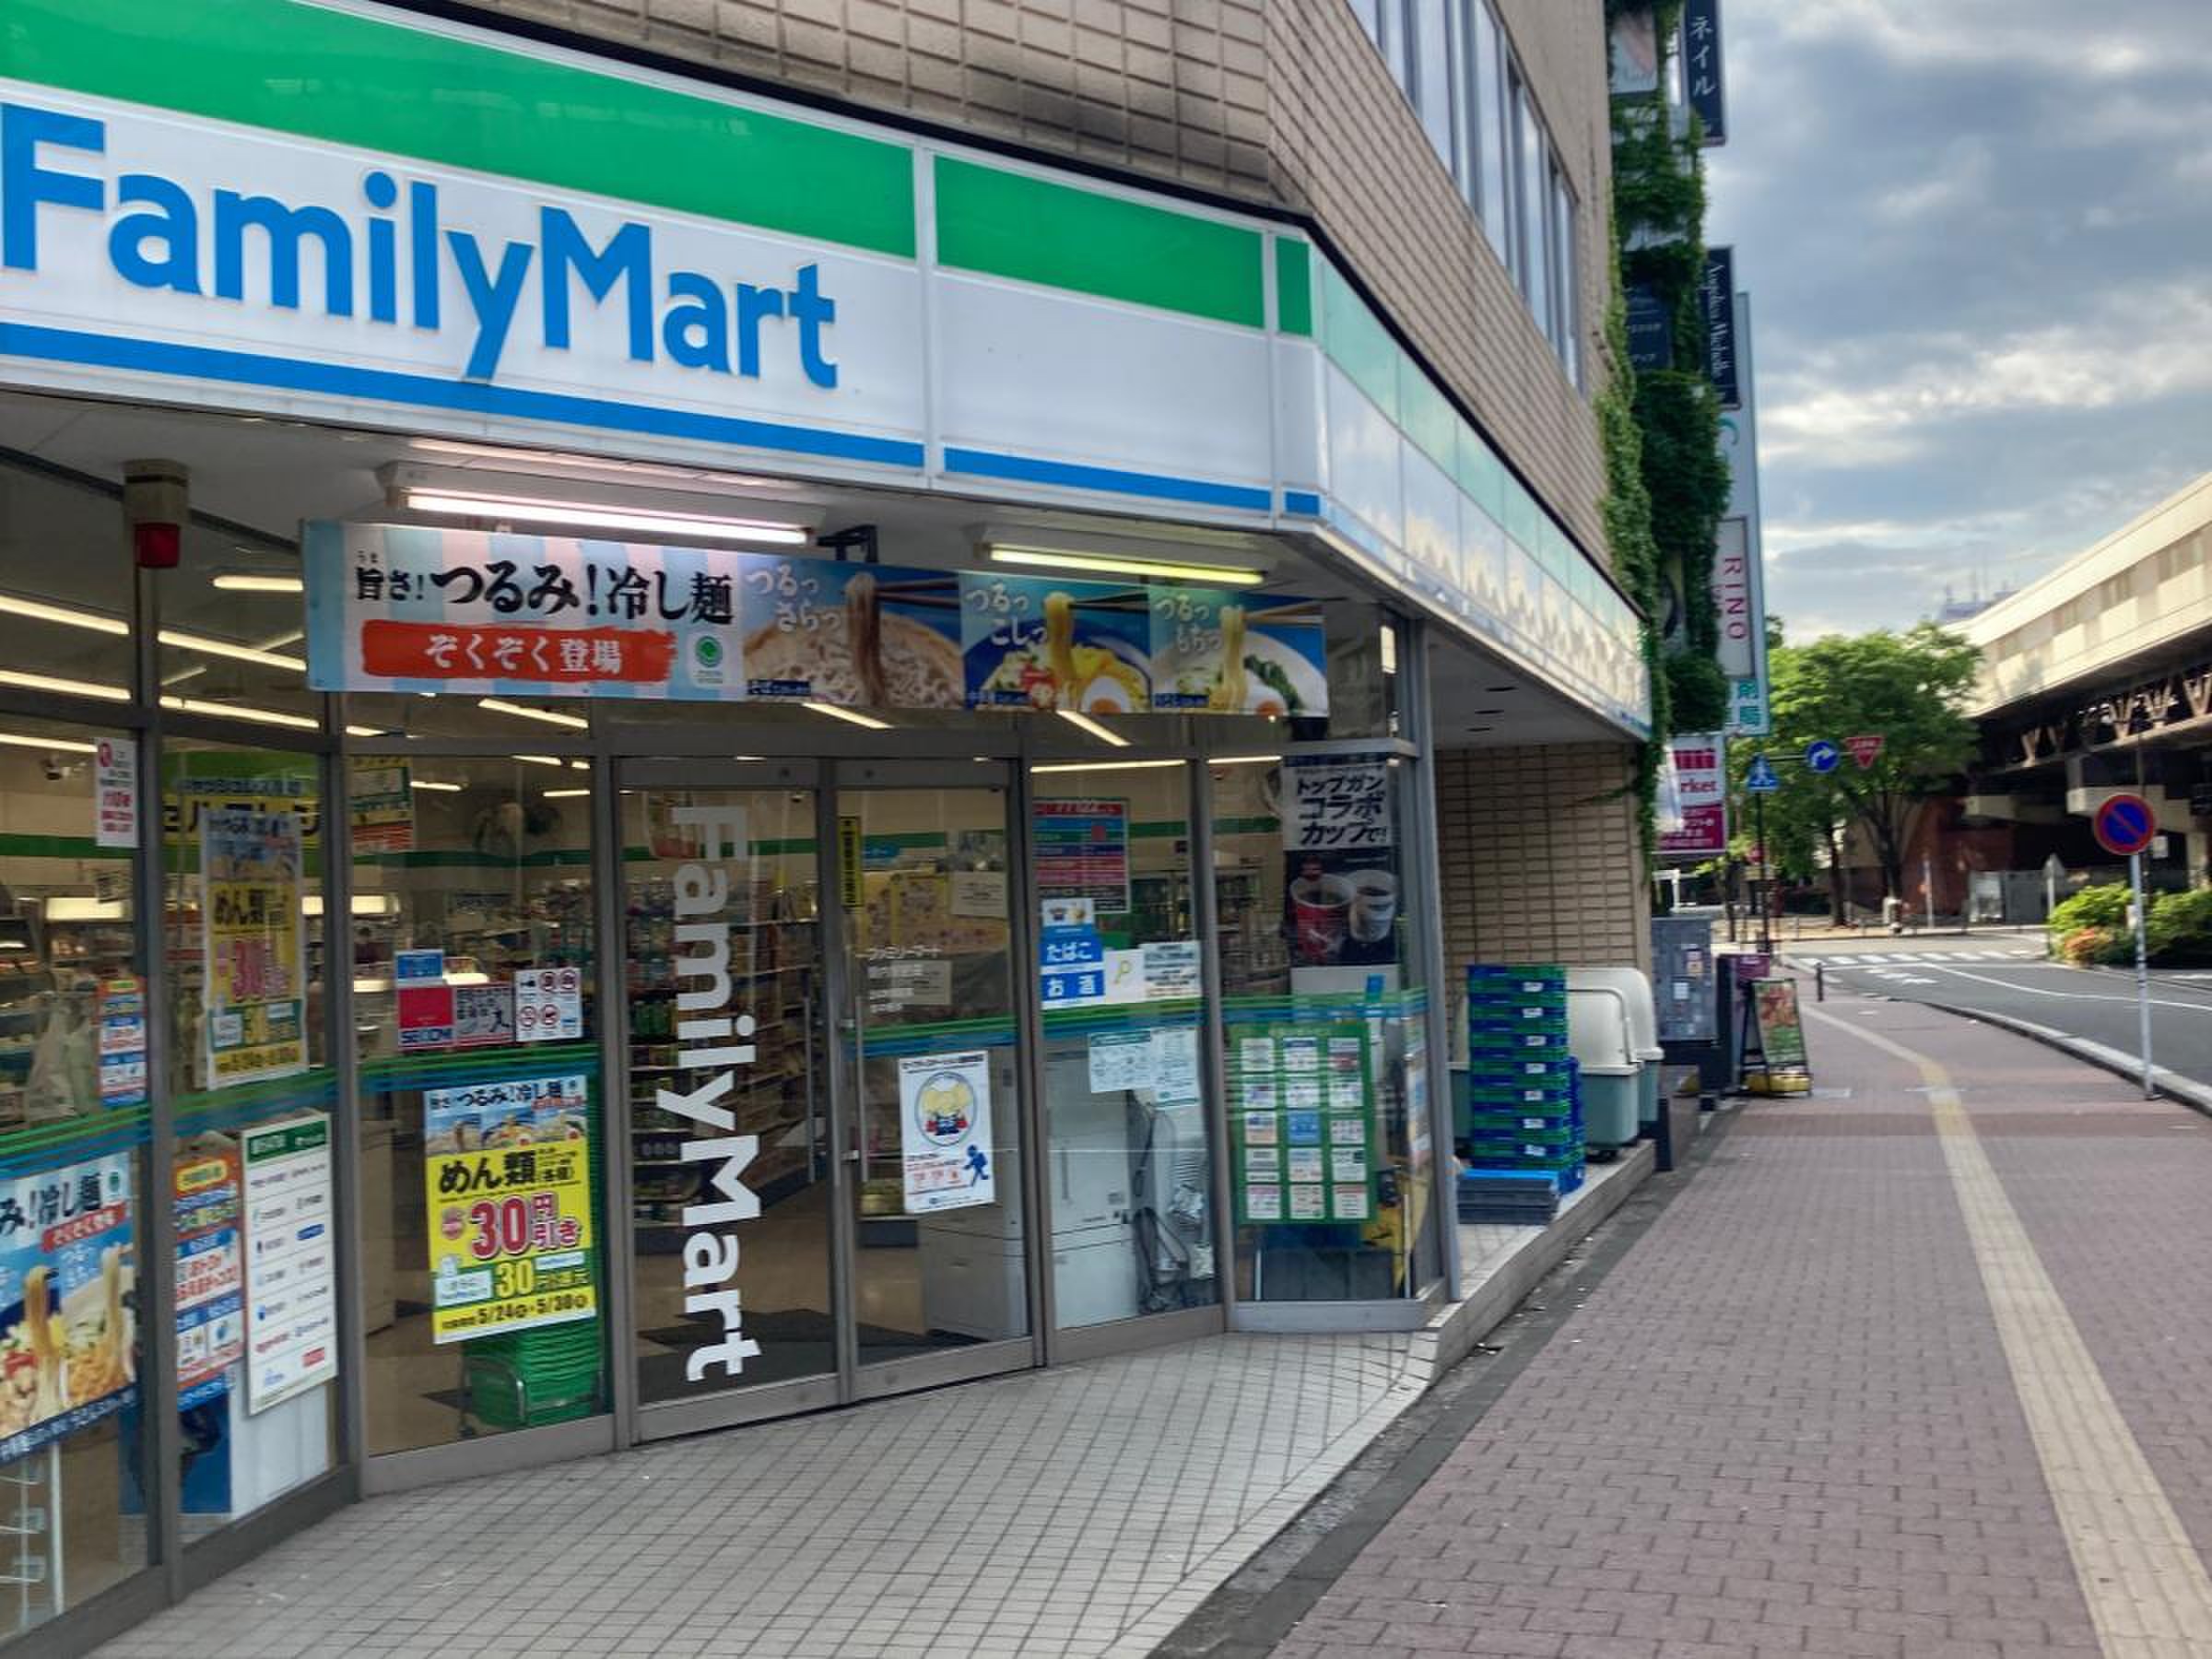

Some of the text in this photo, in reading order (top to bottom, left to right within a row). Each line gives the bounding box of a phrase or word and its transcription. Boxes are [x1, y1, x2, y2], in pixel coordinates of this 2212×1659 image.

[1688, 16, 1716, 96] ネイル
[0, 102, 838, 388] FamilyMart
[1724, 558, 1747, 640] RINO
[425, 634, 622, 675] ぞくぞく登場
[1297, 775, 1385, 795] トップガン
[656, 805, 761, 1382] FamilyMart
[439, 1149, 536, 1194] めん類
